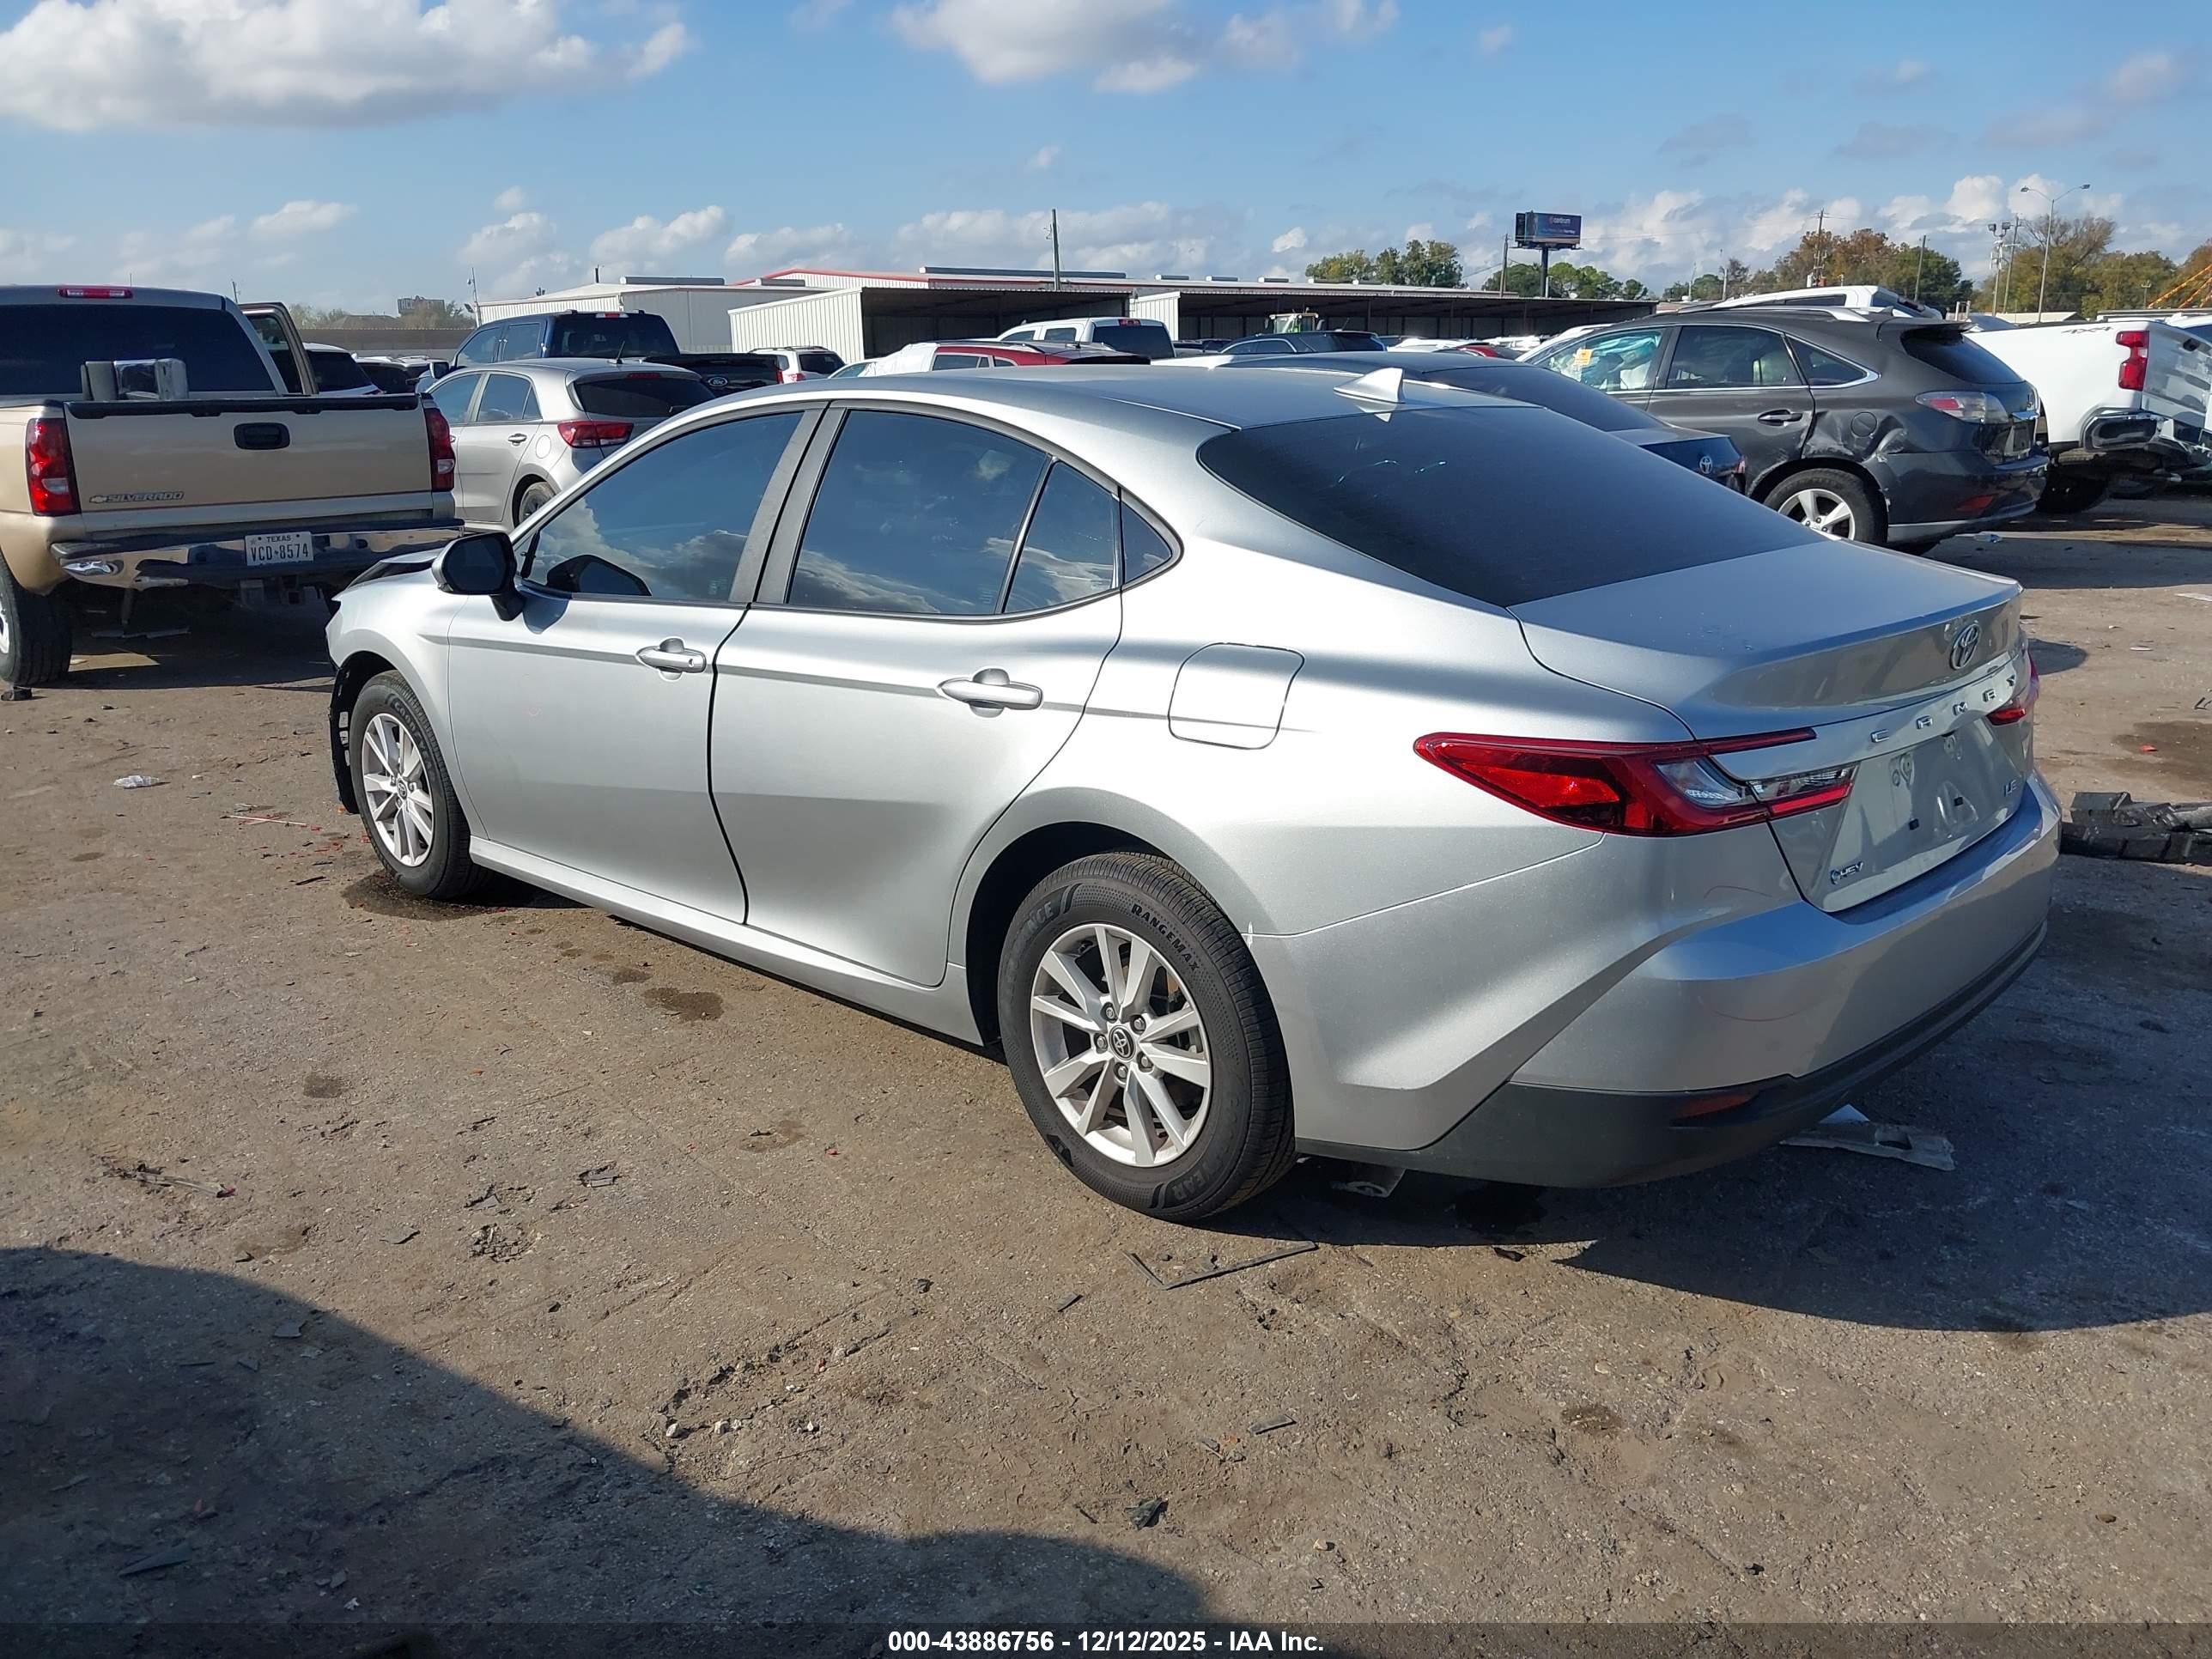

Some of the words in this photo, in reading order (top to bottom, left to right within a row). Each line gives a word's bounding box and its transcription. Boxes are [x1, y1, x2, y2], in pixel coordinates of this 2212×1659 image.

[106, 491, 185, 503] SILVERADO
[1870, 674, 2016, 744] CAMRY
[2003, 779, 2018, 797] LE
[1131, 902, 1200, 971] RANGEMAX
